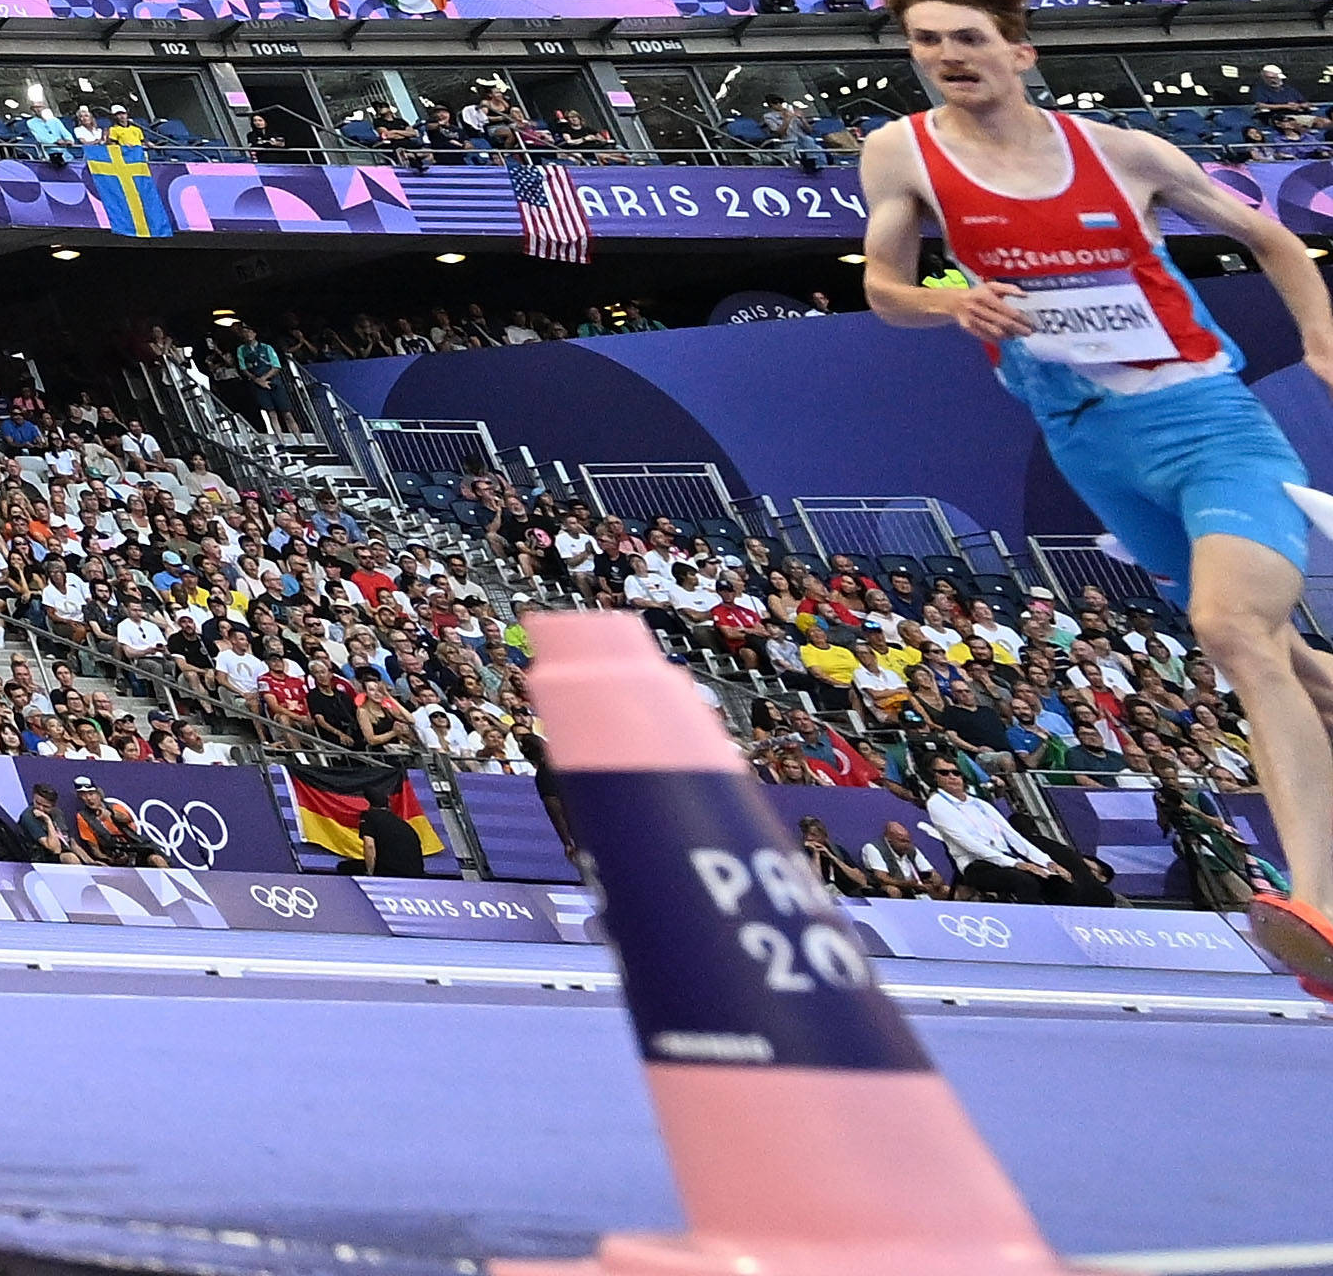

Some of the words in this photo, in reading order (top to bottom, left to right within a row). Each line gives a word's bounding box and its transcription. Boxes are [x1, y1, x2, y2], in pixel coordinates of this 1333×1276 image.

[161, 42, 190, 56] 102
[534, 41, 565, 54] 101
[715, 185, 867, 218] 2024
[462, 900, 534, 921] 2024
[1157, 930, 1234, 950] 2024
